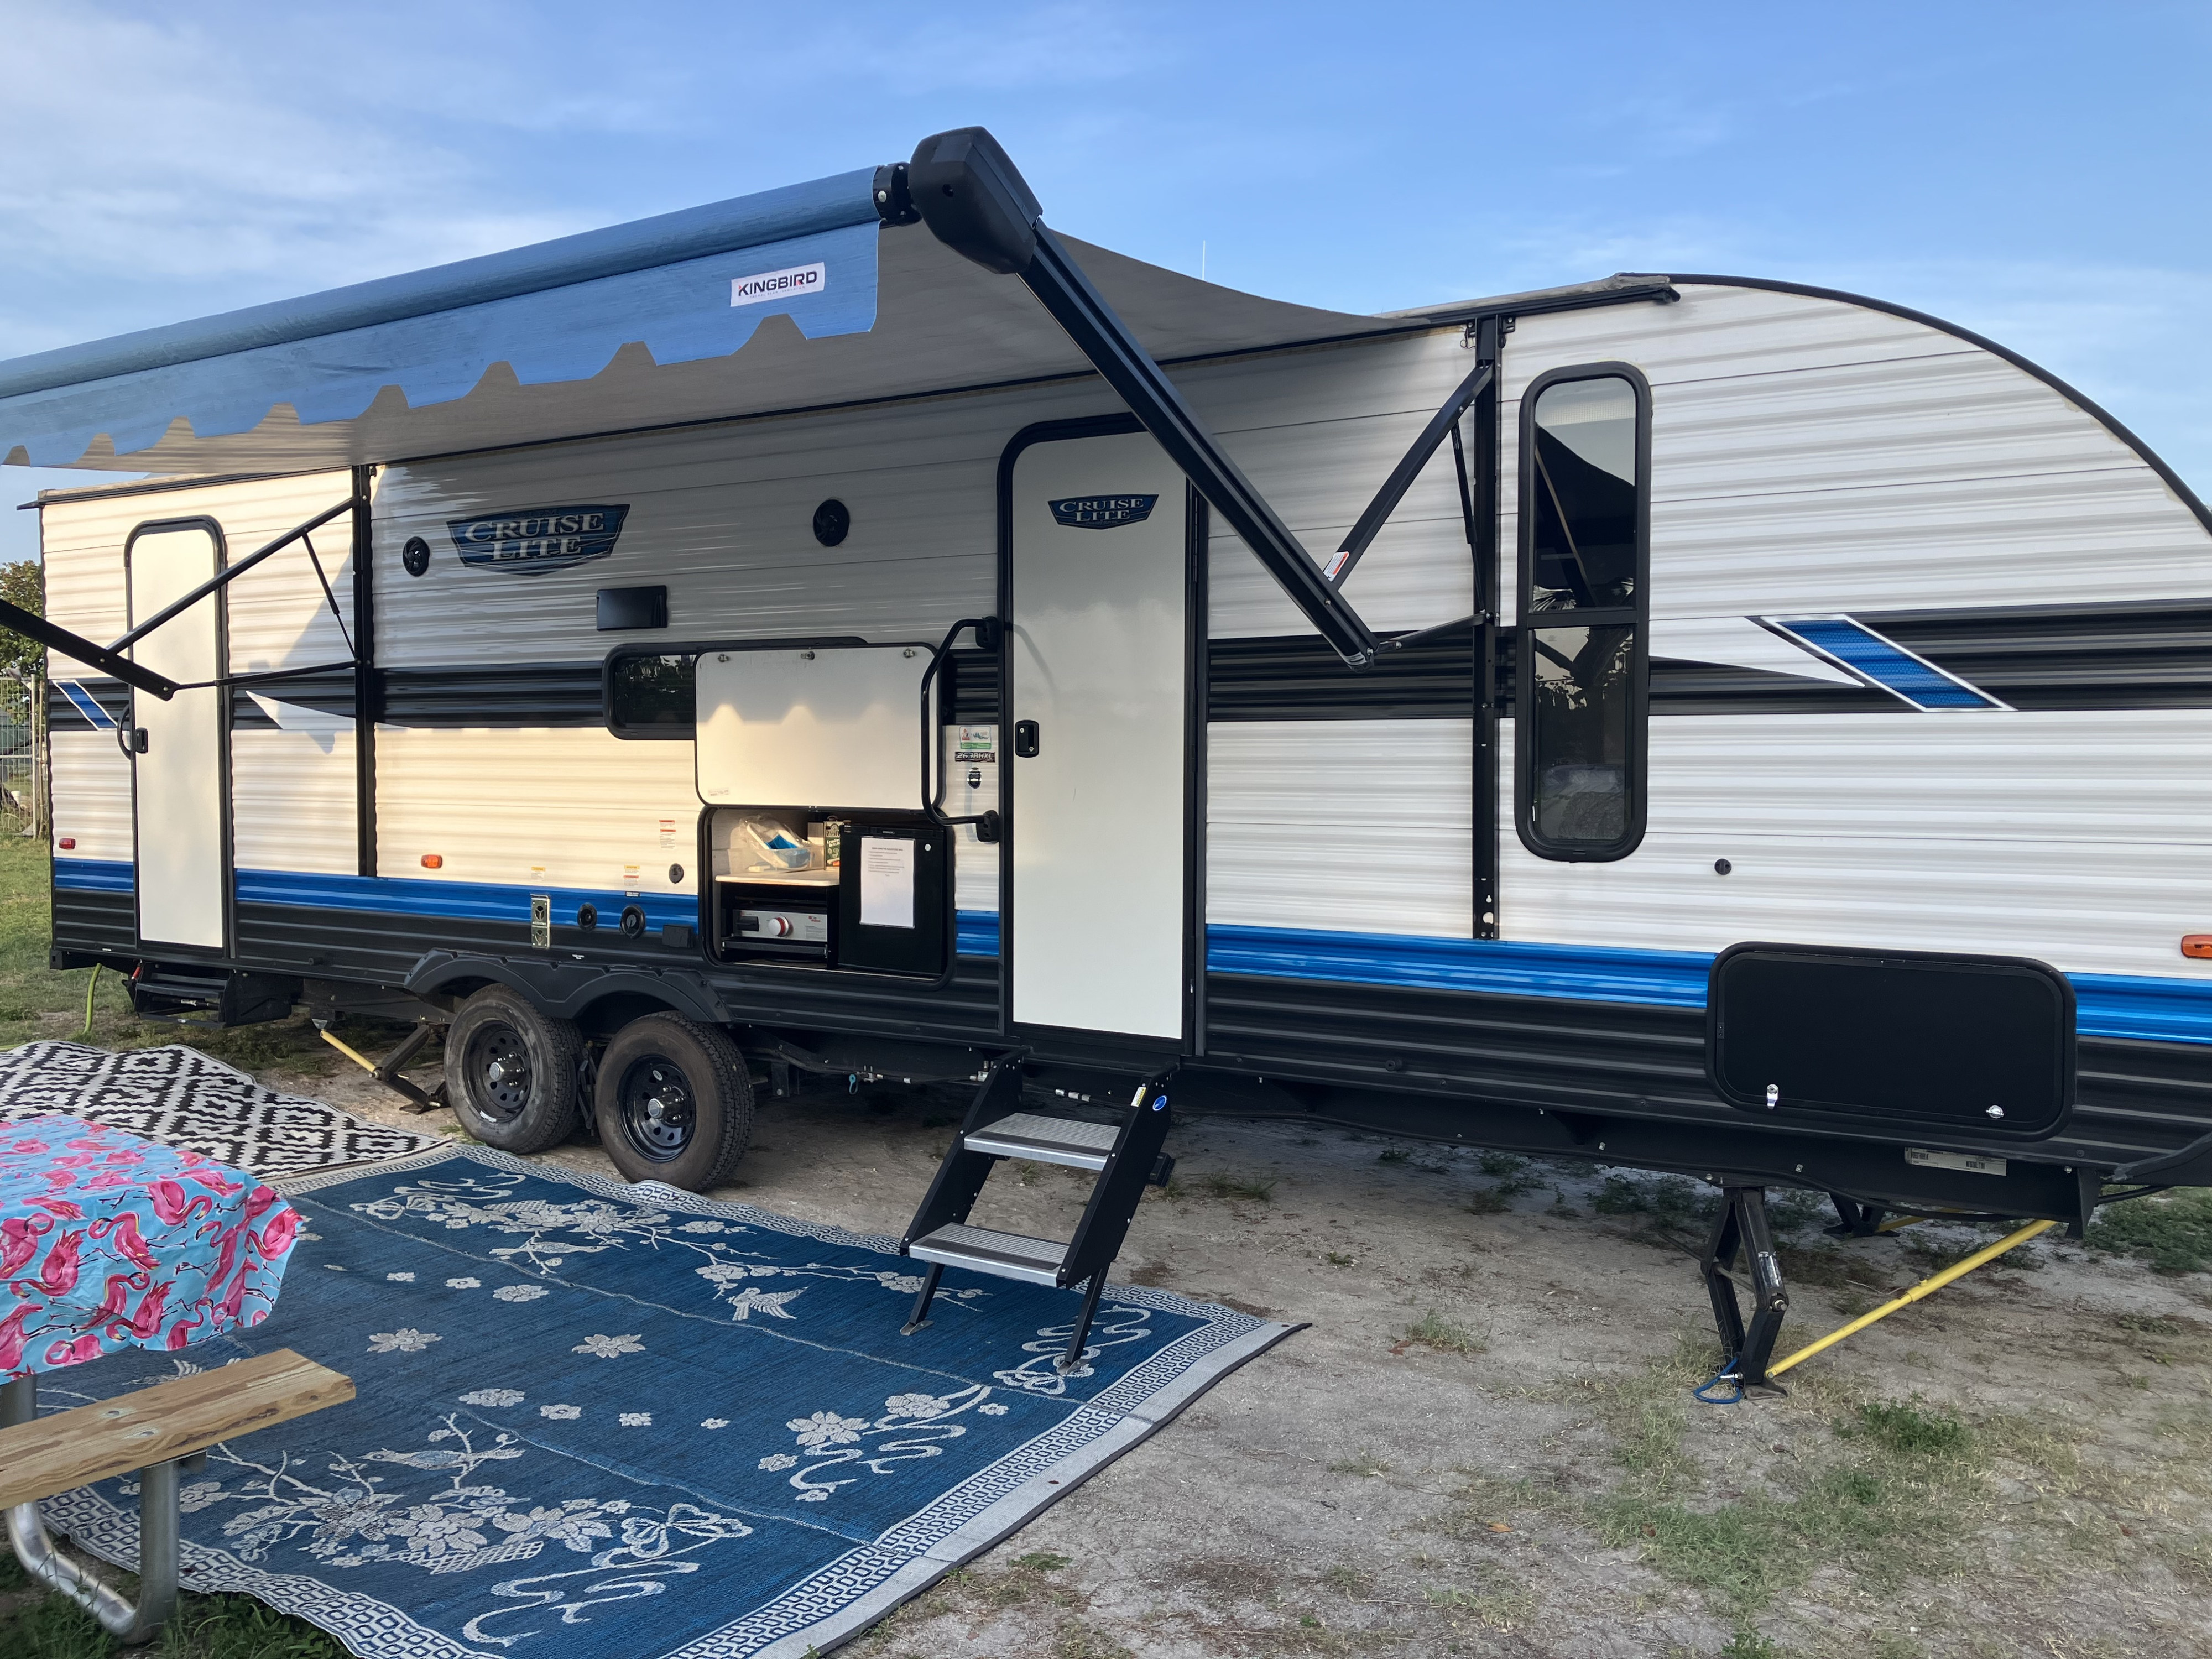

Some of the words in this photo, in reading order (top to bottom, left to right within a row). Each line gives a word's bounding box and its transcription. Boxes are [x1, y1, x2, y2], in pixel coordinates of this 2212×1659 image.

[738, 270, 817, 296] KINGBIRD
[1059, 498, 1144, 513] CRUISE
[1074, 509, 1131, 522] LITE
[464, 512, 605, 542] CRUISE
[490, 535, 582, 561] LITE
